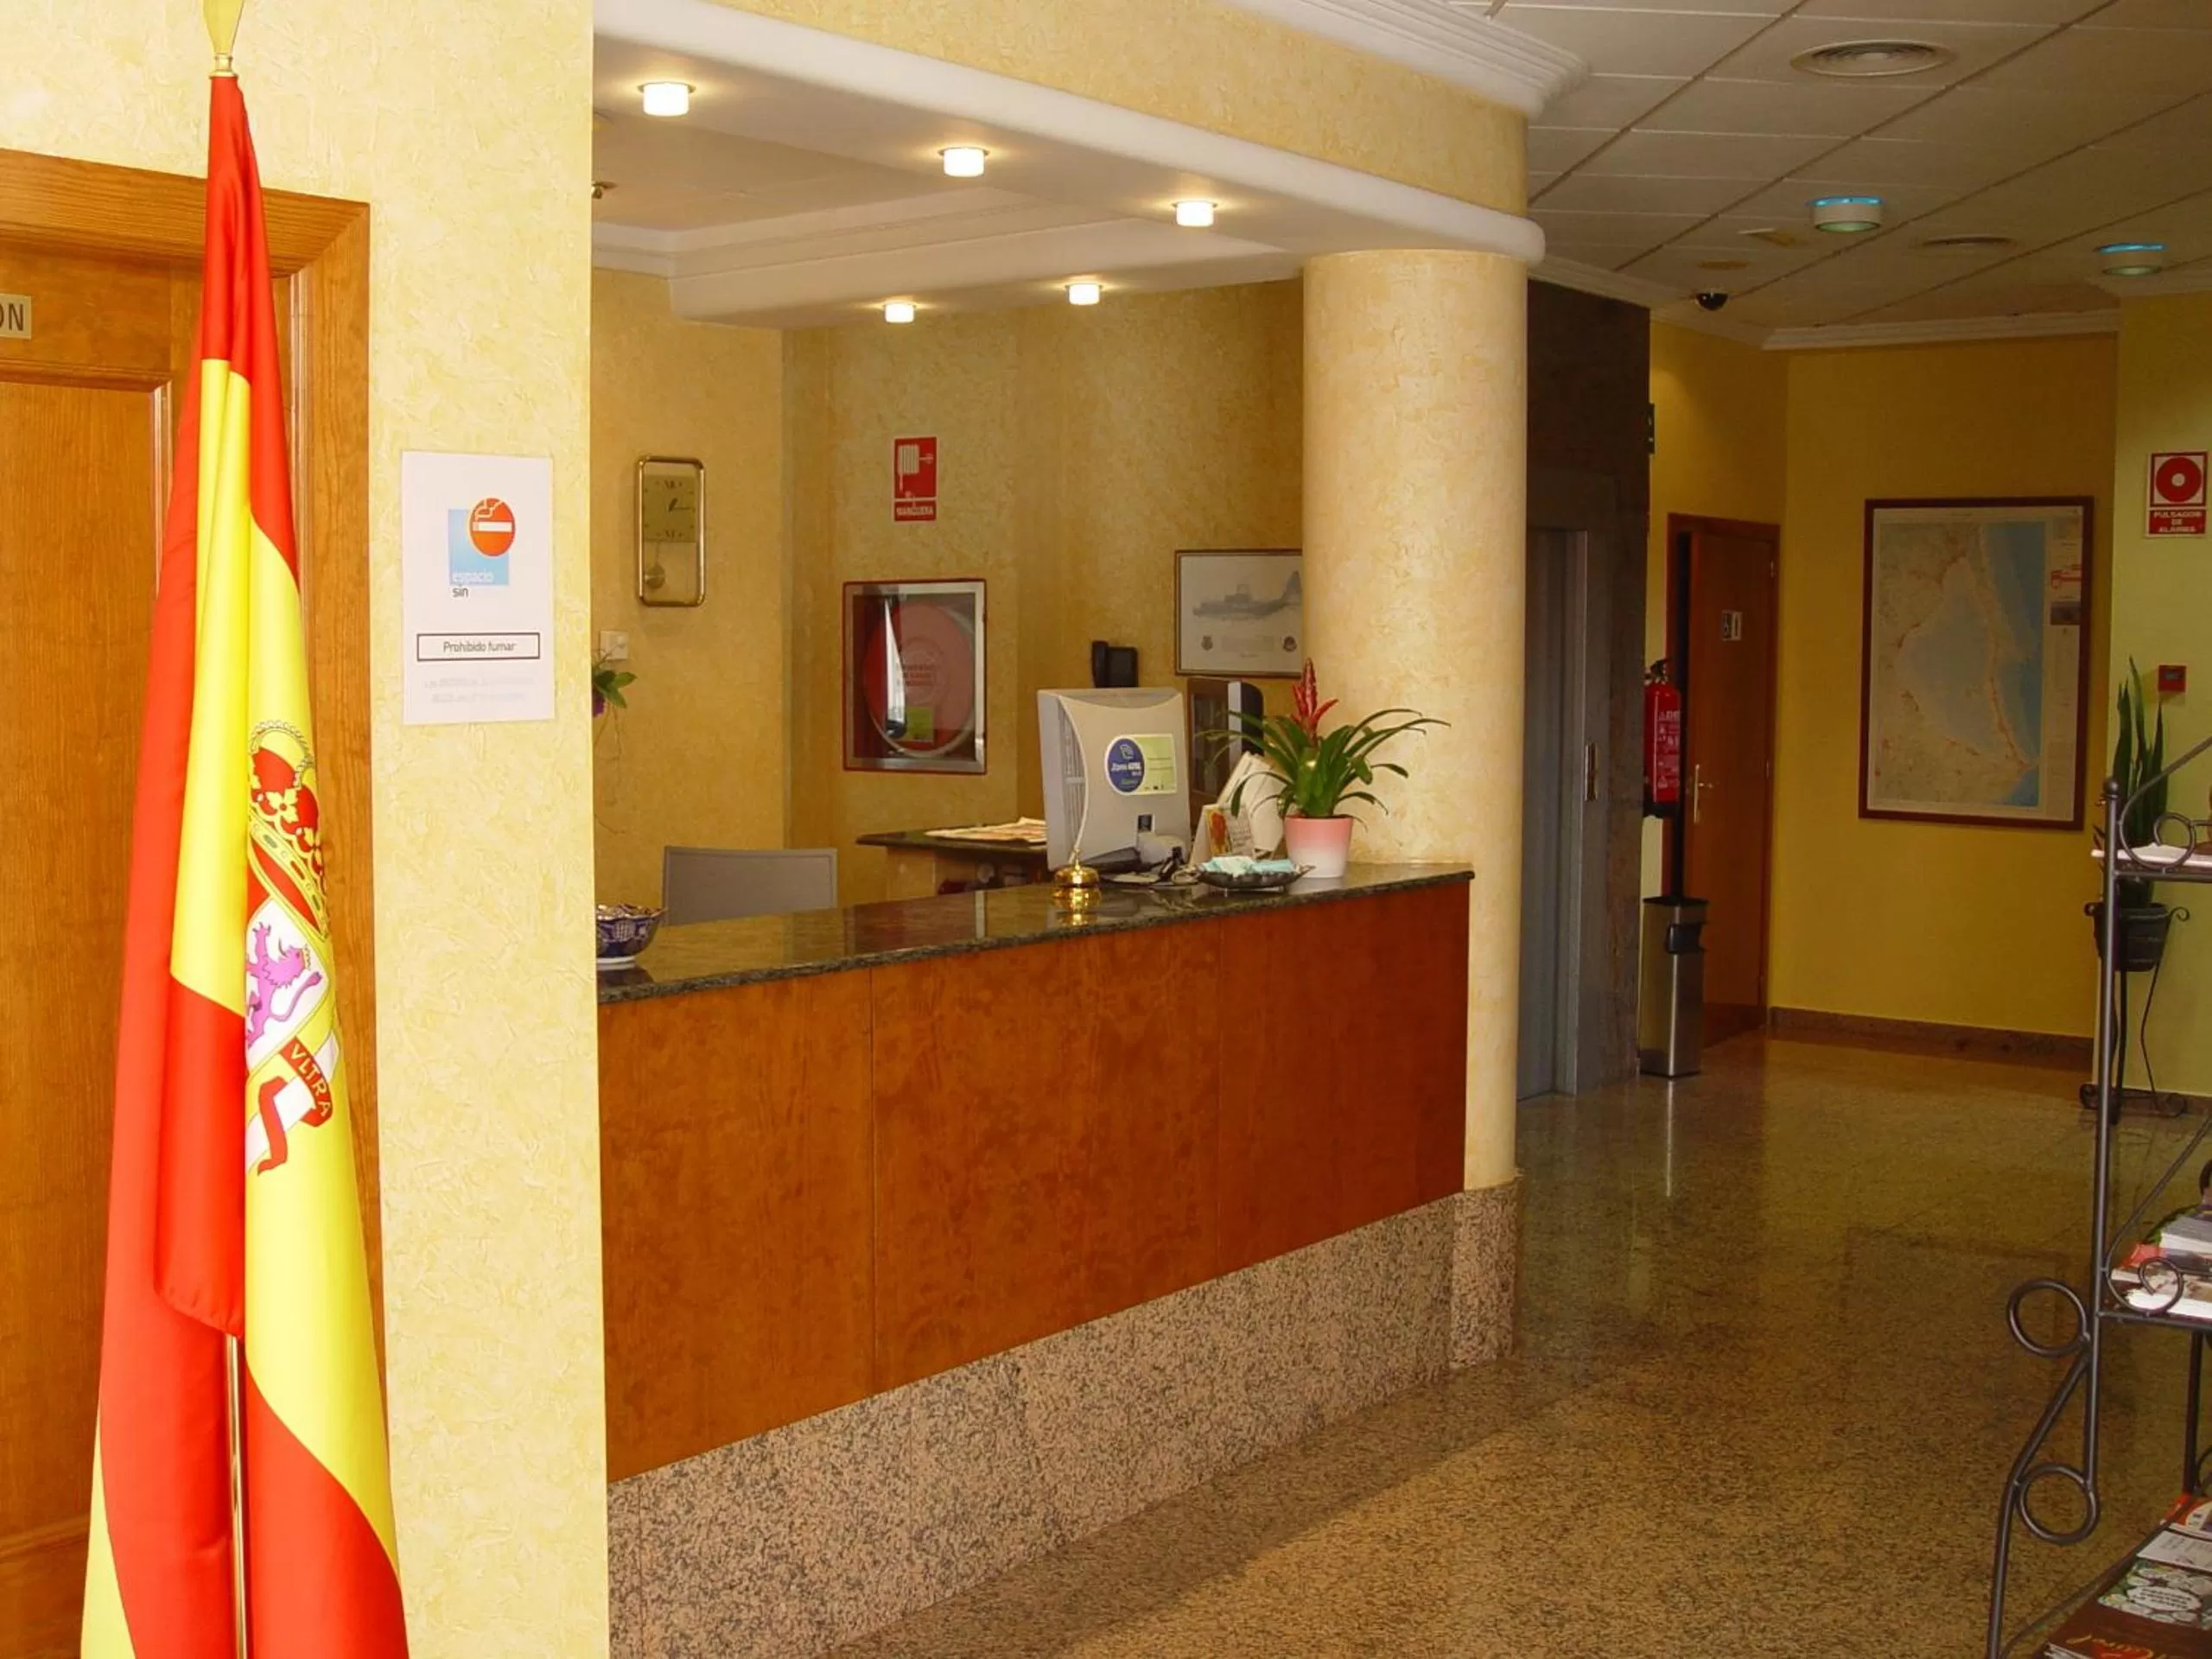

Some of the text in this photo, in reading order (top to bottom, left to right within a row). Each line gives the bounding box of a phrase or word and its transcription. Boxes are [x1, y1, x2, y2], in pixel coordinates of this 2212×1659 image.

[0, 303, 24, 331] N
[452, 585, 469, 598] sin
[442, 639, 517, 653] Prohibido fumar
